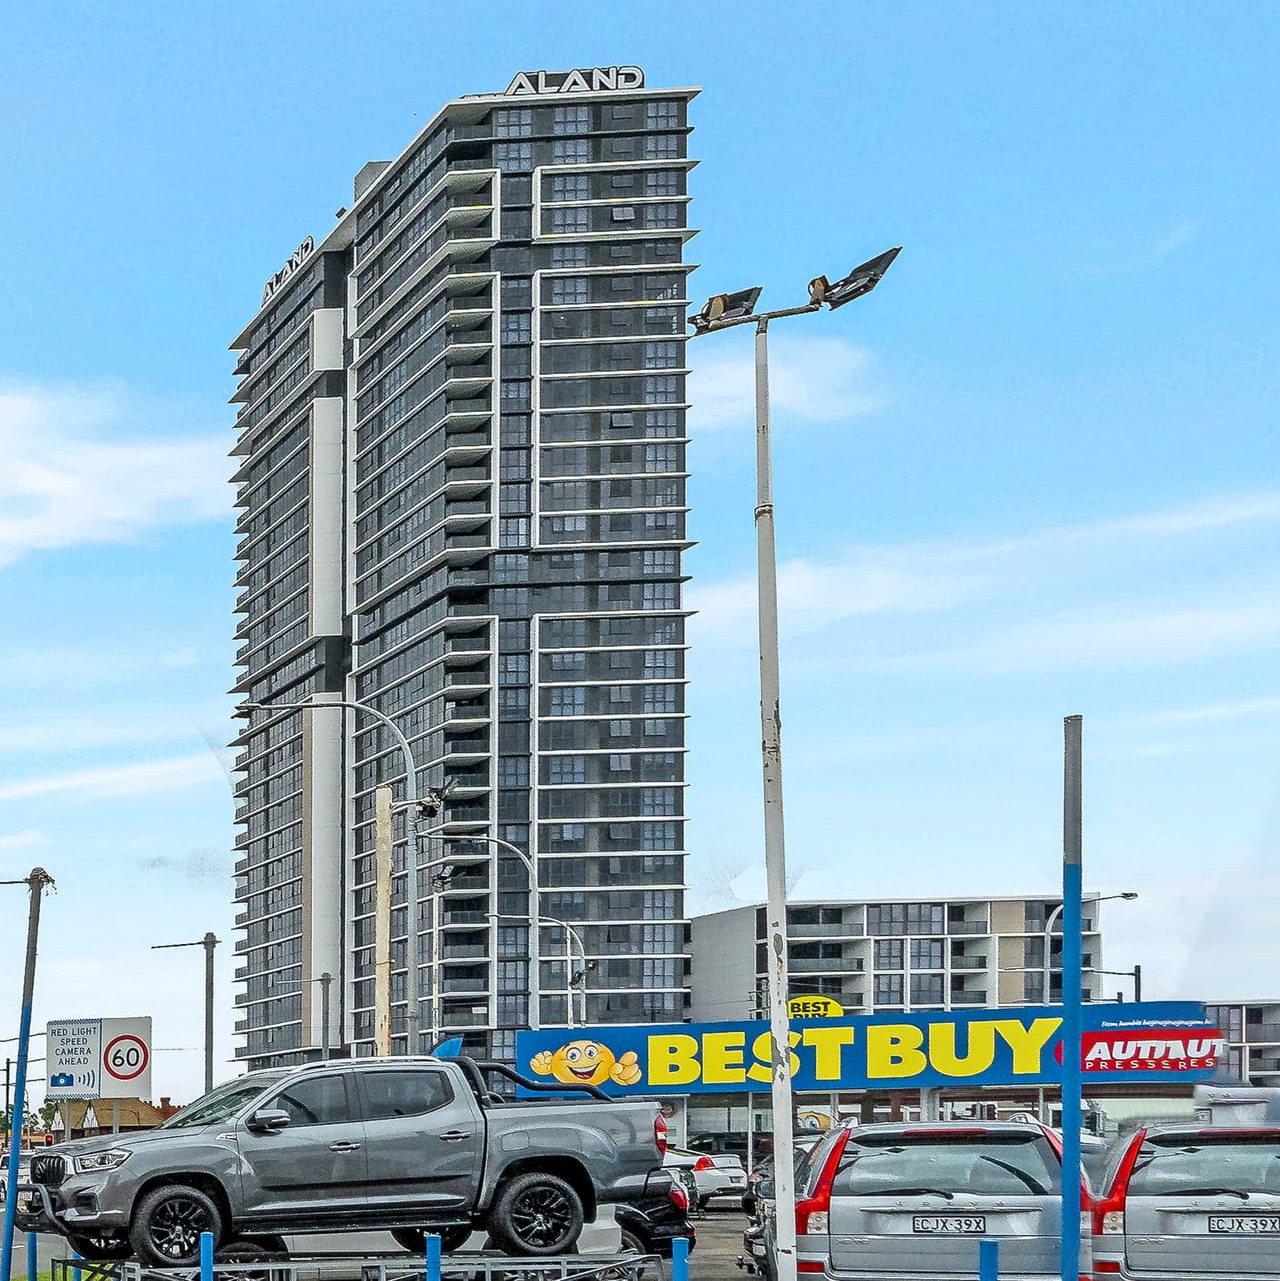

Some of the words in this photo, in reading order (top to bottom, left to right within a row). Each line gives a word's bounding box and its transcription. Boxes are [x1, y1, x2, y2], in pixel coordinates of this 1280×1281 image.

[504, 66, 644, 95] ALAND
[261, 235, 314, 308] ALAND
[791, 1001, 830, 1013] BEST
[51, 1028, 68, 1037] RED
[72, 1027, 97, 1036] LIGHT
[60, 1037, 88, 1046] SPEED
[55, 1047, 92, 1056] CAMERA
[112, 1047, 140, 1067] 60
[647, 1026, 855, 1086] BEST
[867, 1017, 1064, 1079] BUY
[58, 1057, 89, 1066] AHEAD
